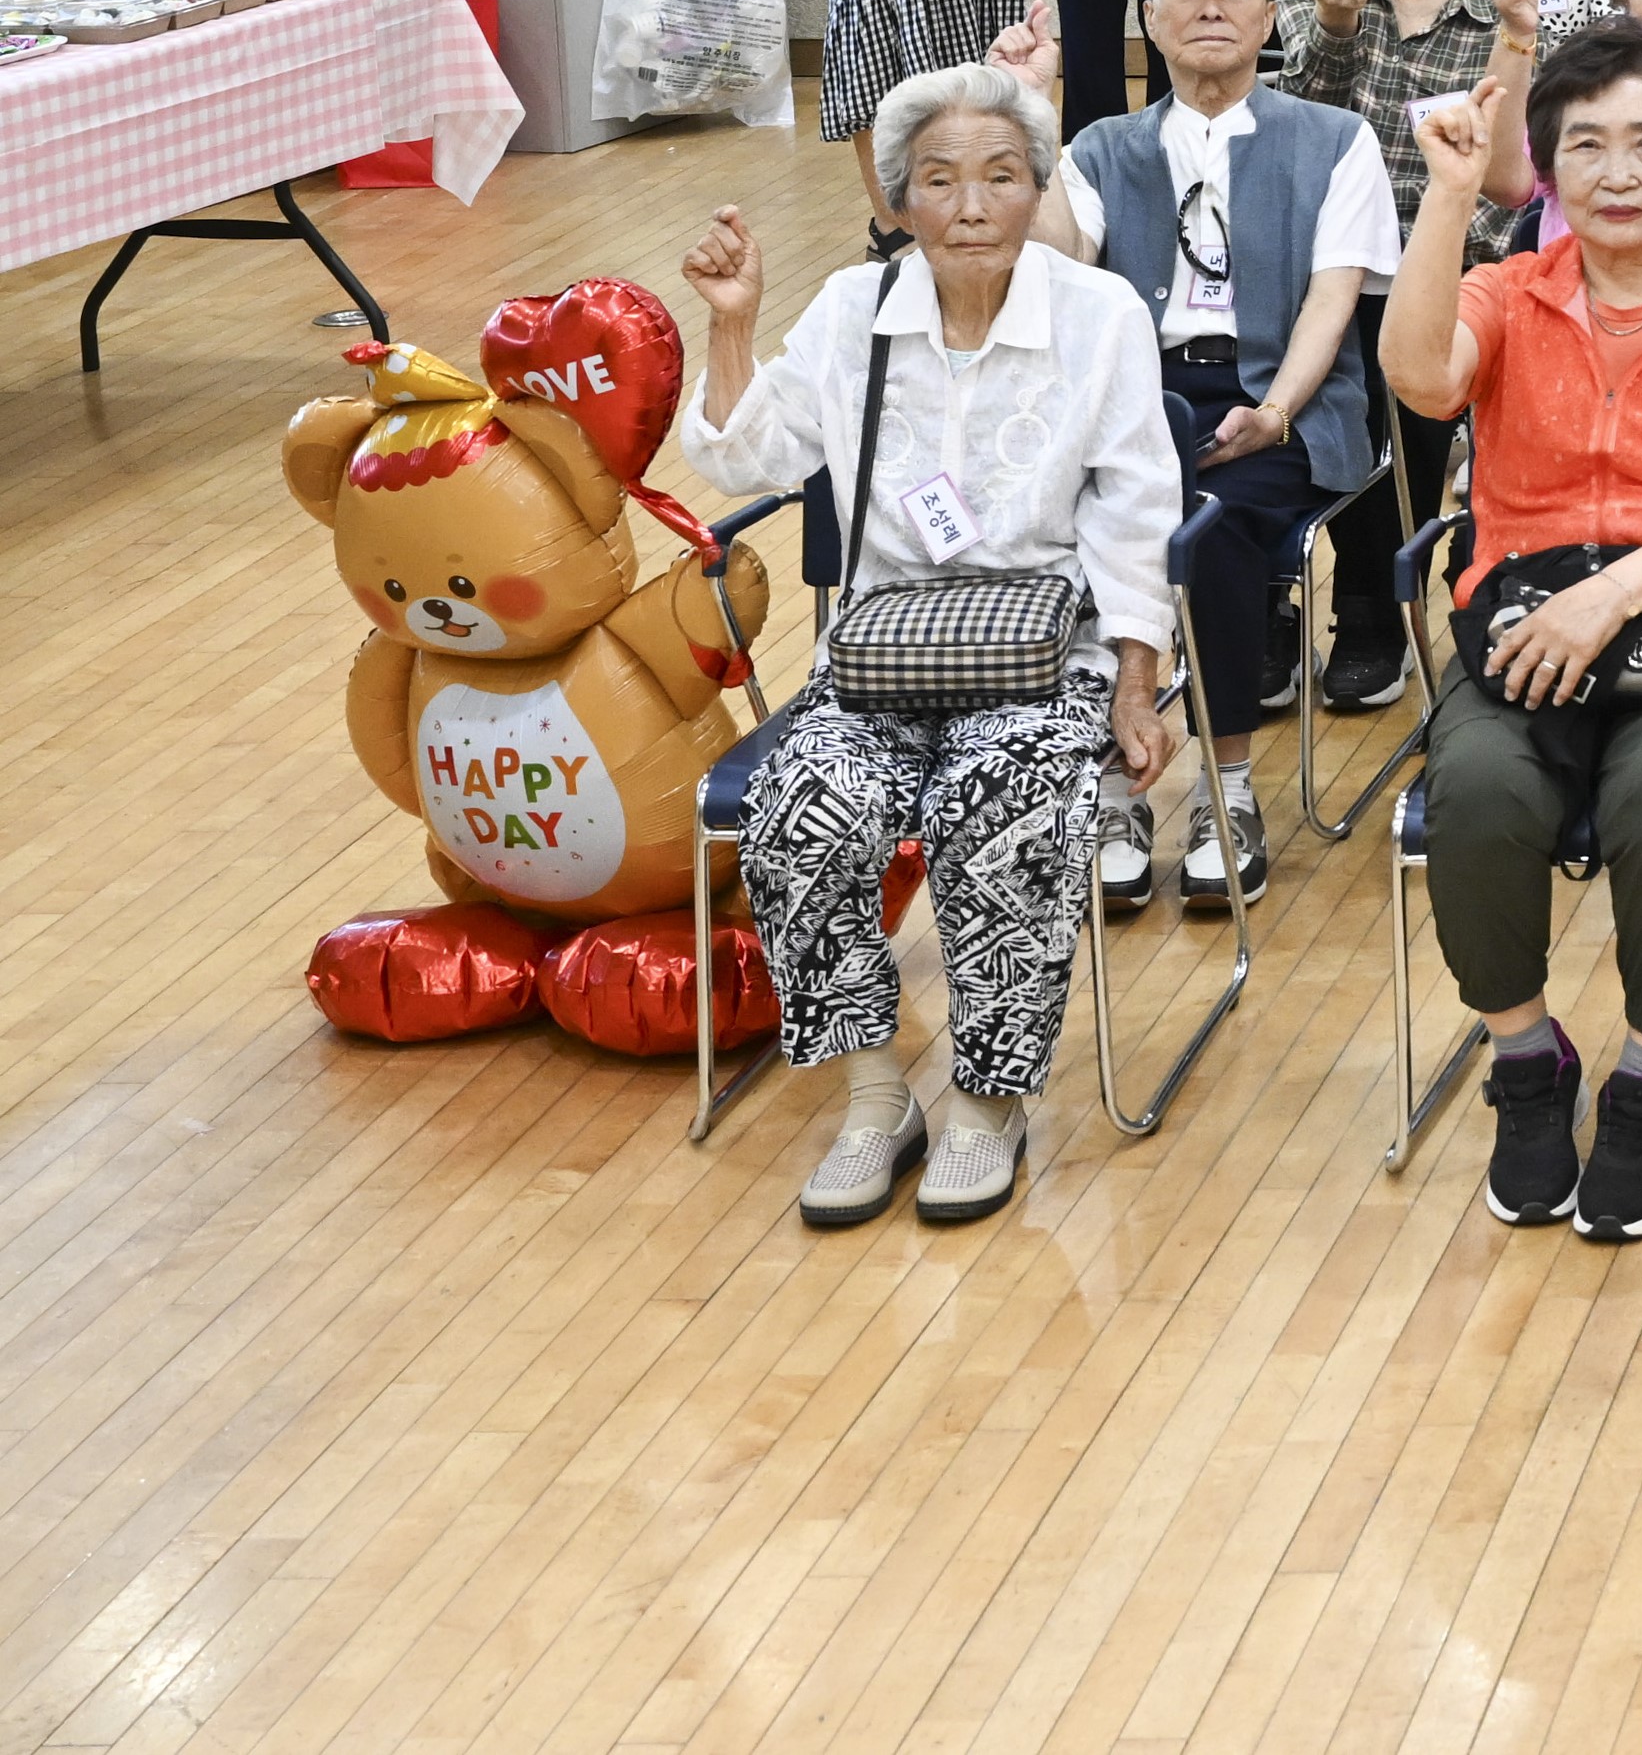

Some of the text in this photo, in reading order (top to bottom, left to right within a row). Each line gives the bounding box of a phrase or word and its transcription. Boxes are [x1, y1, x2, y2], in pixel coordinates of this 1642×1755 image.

[1202, 252, 1224, 299] 김도
[427, 745, 590, 804] HAPPY
[462, 807, 563, 851] DAY
